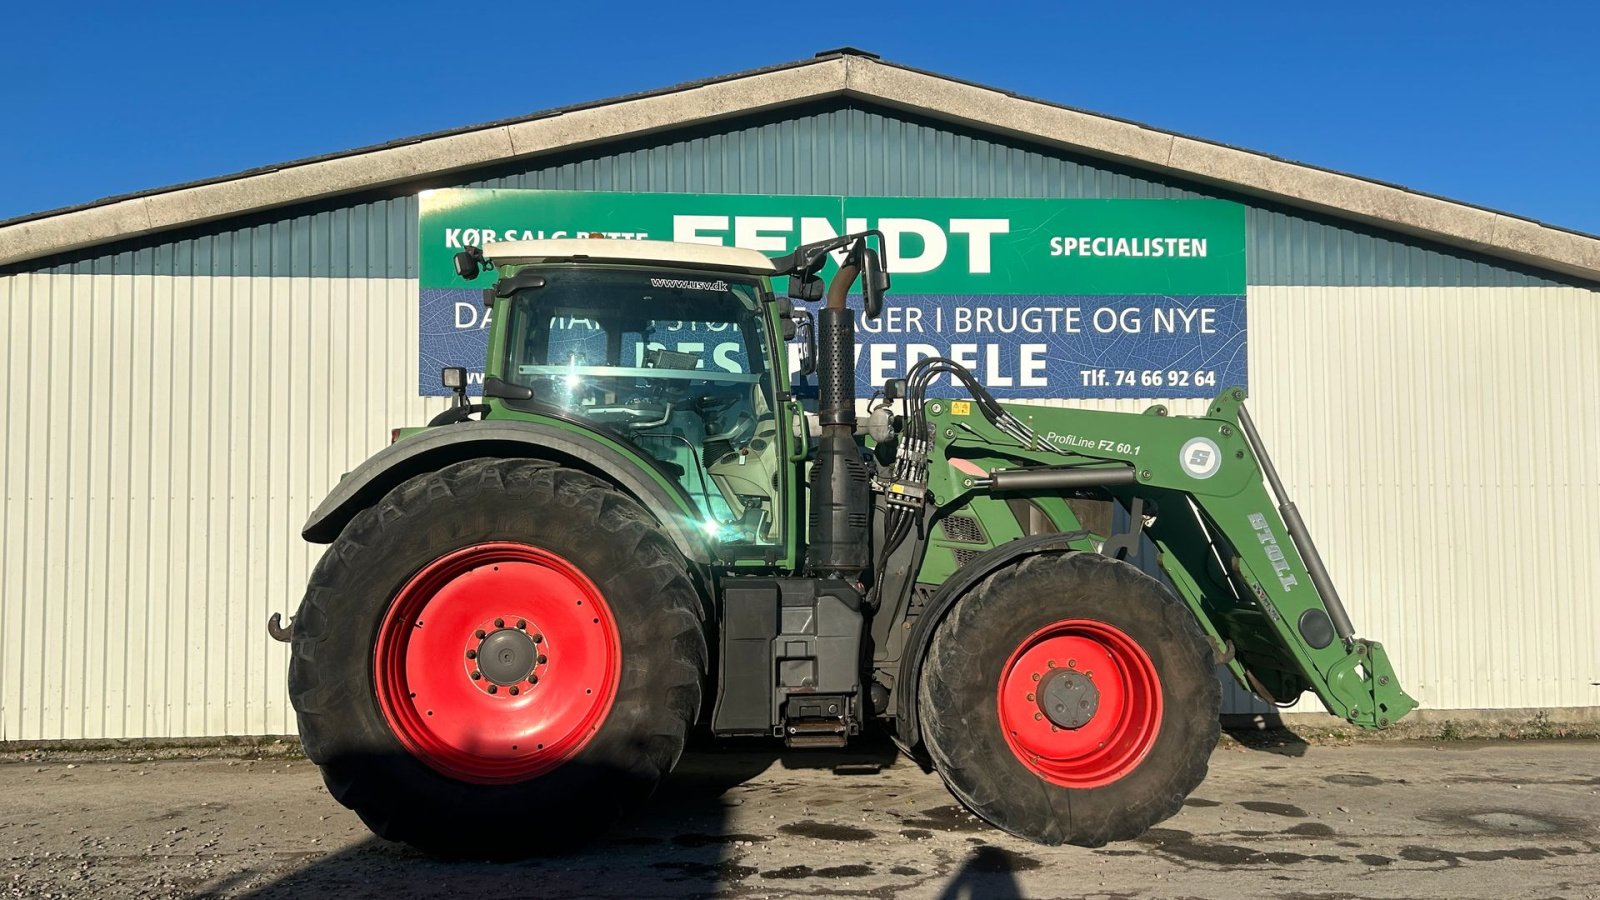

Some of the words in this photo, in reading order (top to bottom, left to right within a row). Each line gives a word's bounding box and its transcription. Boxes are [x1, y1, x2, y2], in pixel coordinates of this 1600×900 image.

[673, 214, 1010, 274] FENDT
[1050, 236, 1208, 258] SPECIALISTEN
[650, 278, 729, 292] www.usv.dk
[936, 307, 942, 332] I
[955, 307, 1081, 334] BRUGTE
[1092, 307, 1141, 334] OG
[1153, 308, 1216, 334] NYE
[1080, 370, 1109, 387] Tlf.
[1115, 371, 1136, 387] 74
[1140, 371, 1162, 387] 66
[1168, 371, 1188, 387] 92
[1194, 371, 1216, 387] 64
[1046, 431, 1096, 449] ProfiLine
[1097, 439, 1114, 452] FZ
[1116, 442, 1141, 456] 60.1
[1247, 511, 1299, 593] STOLL
